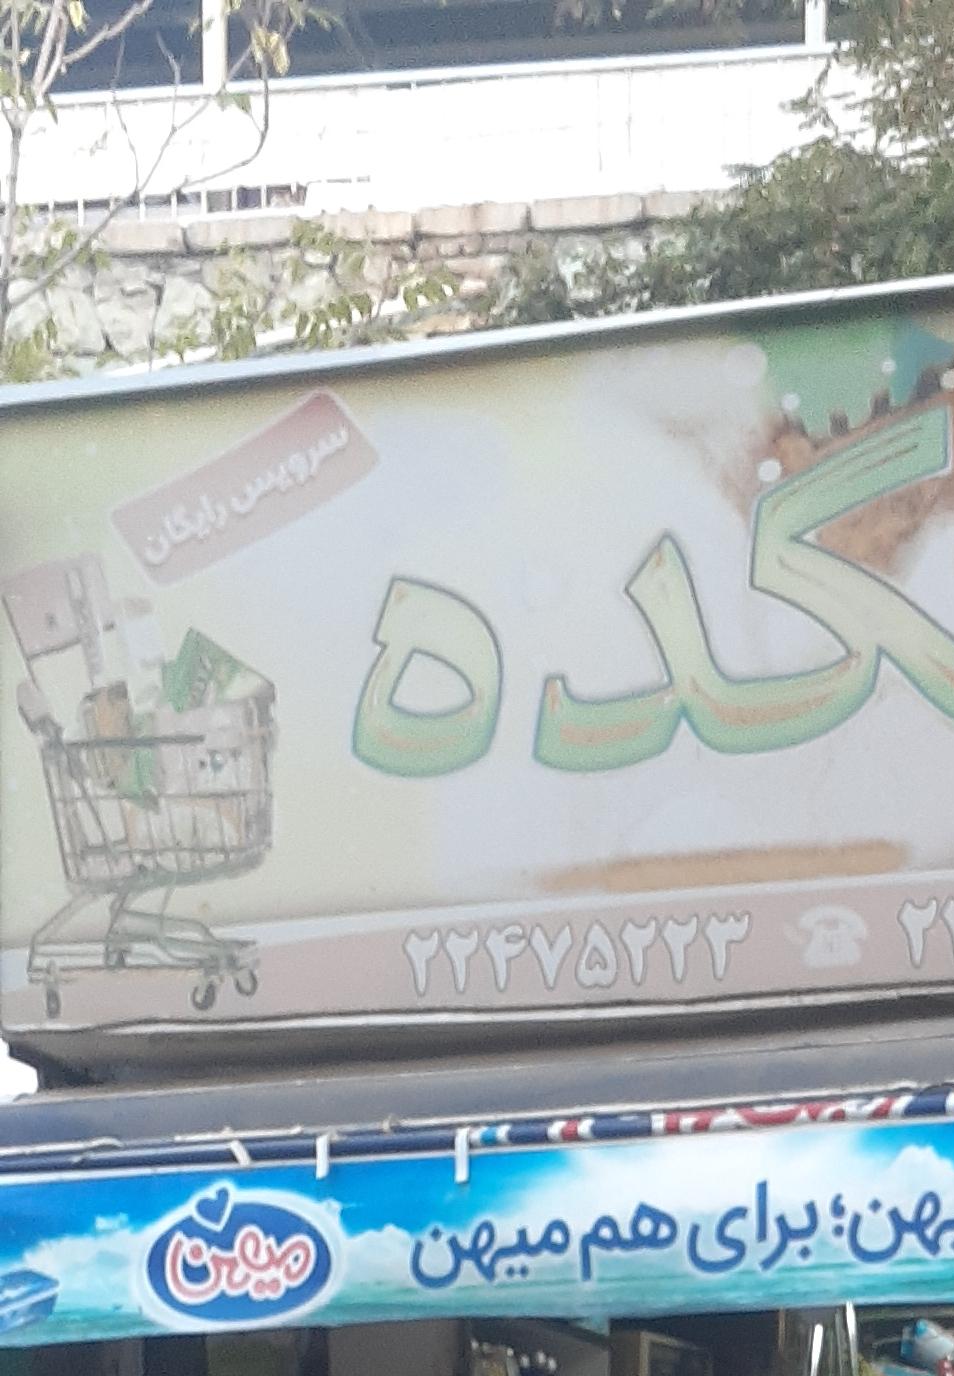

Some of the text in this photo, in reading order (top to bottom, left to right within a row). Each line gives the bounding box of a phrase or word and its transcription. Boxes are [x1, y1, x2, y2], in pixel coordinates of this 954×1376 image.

[142, 422, 354, 566] سرویس رایگان
[404, 908, 751, 996] ۲۲۴۷۵۲۲۳
[166, 1223, 317, 1302] میهن
[411, 1217, 572, 1289] میهن
[579, 1202, 676, 1284] هم
[686, 1180, 818, 1274] برای
